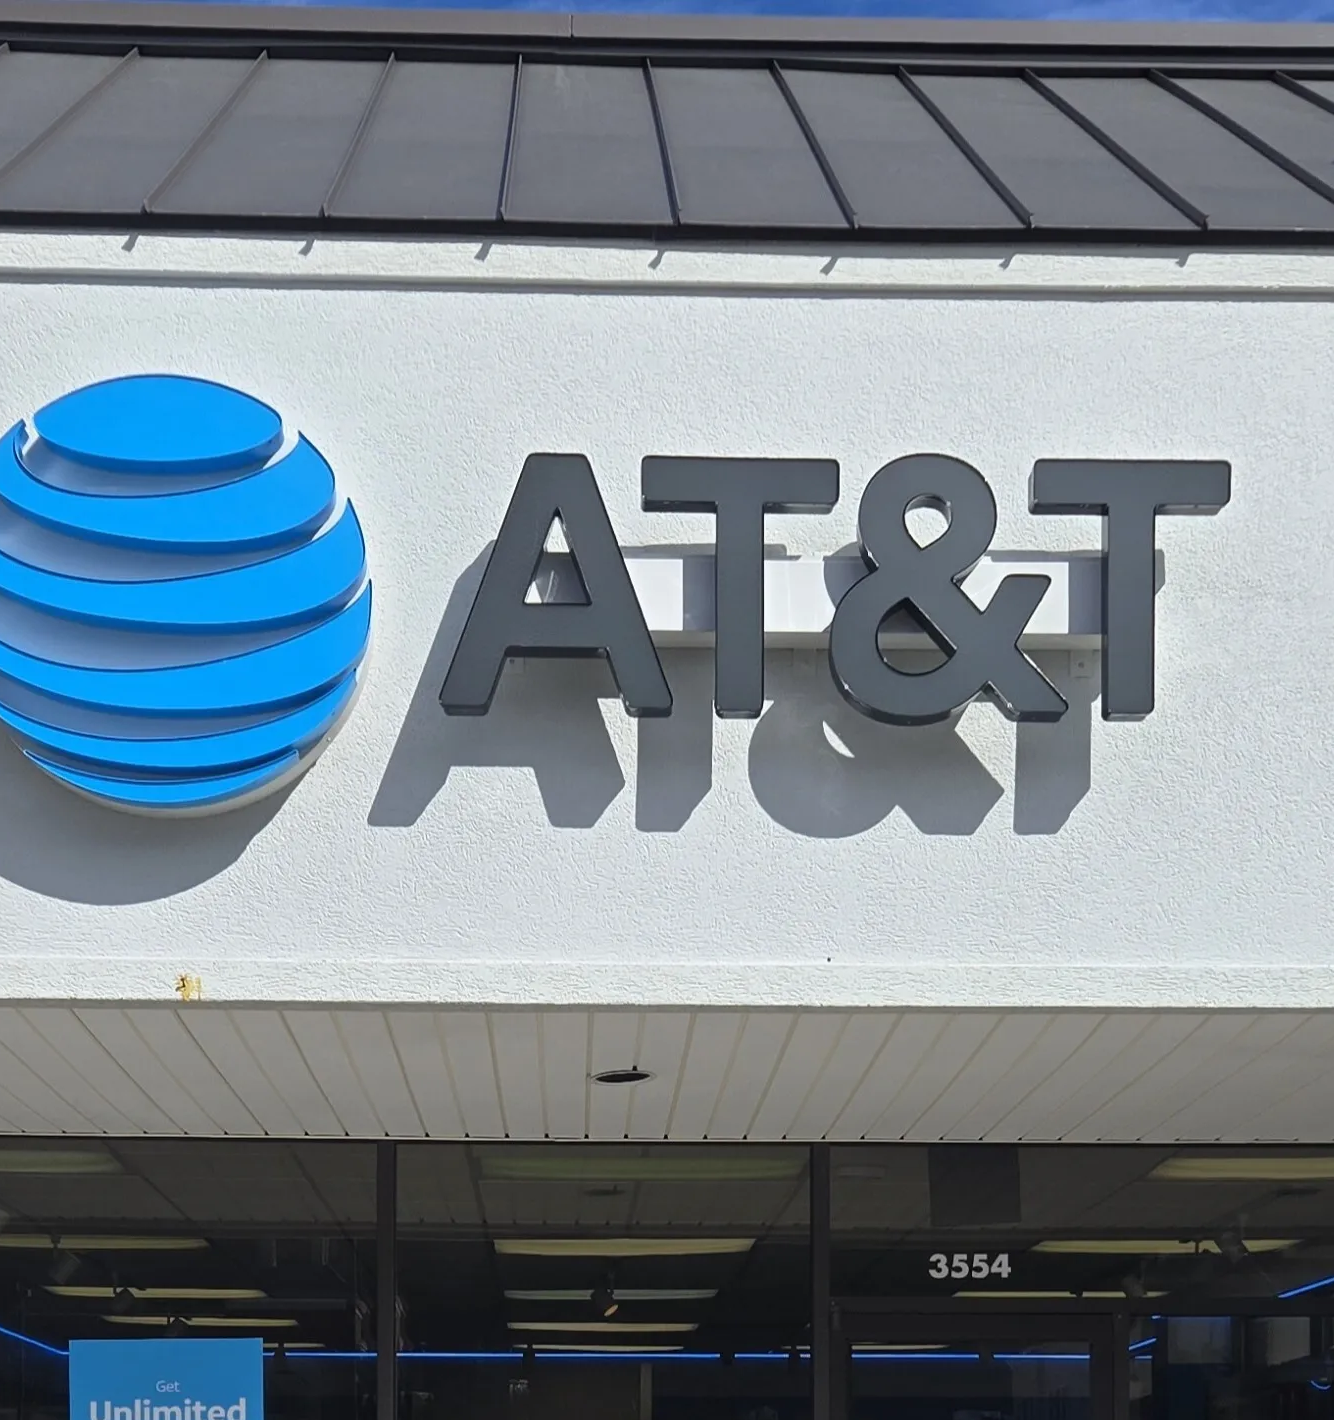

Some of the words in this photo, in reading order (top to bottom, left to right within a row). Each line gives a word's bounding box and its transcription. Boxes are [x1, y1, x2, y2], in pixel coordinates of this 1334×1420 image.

[439, 452, 1231, 724] AT&T
[928, 1253, 1012, 1279] 3554
[155, 1380, 180, 1393] Get
